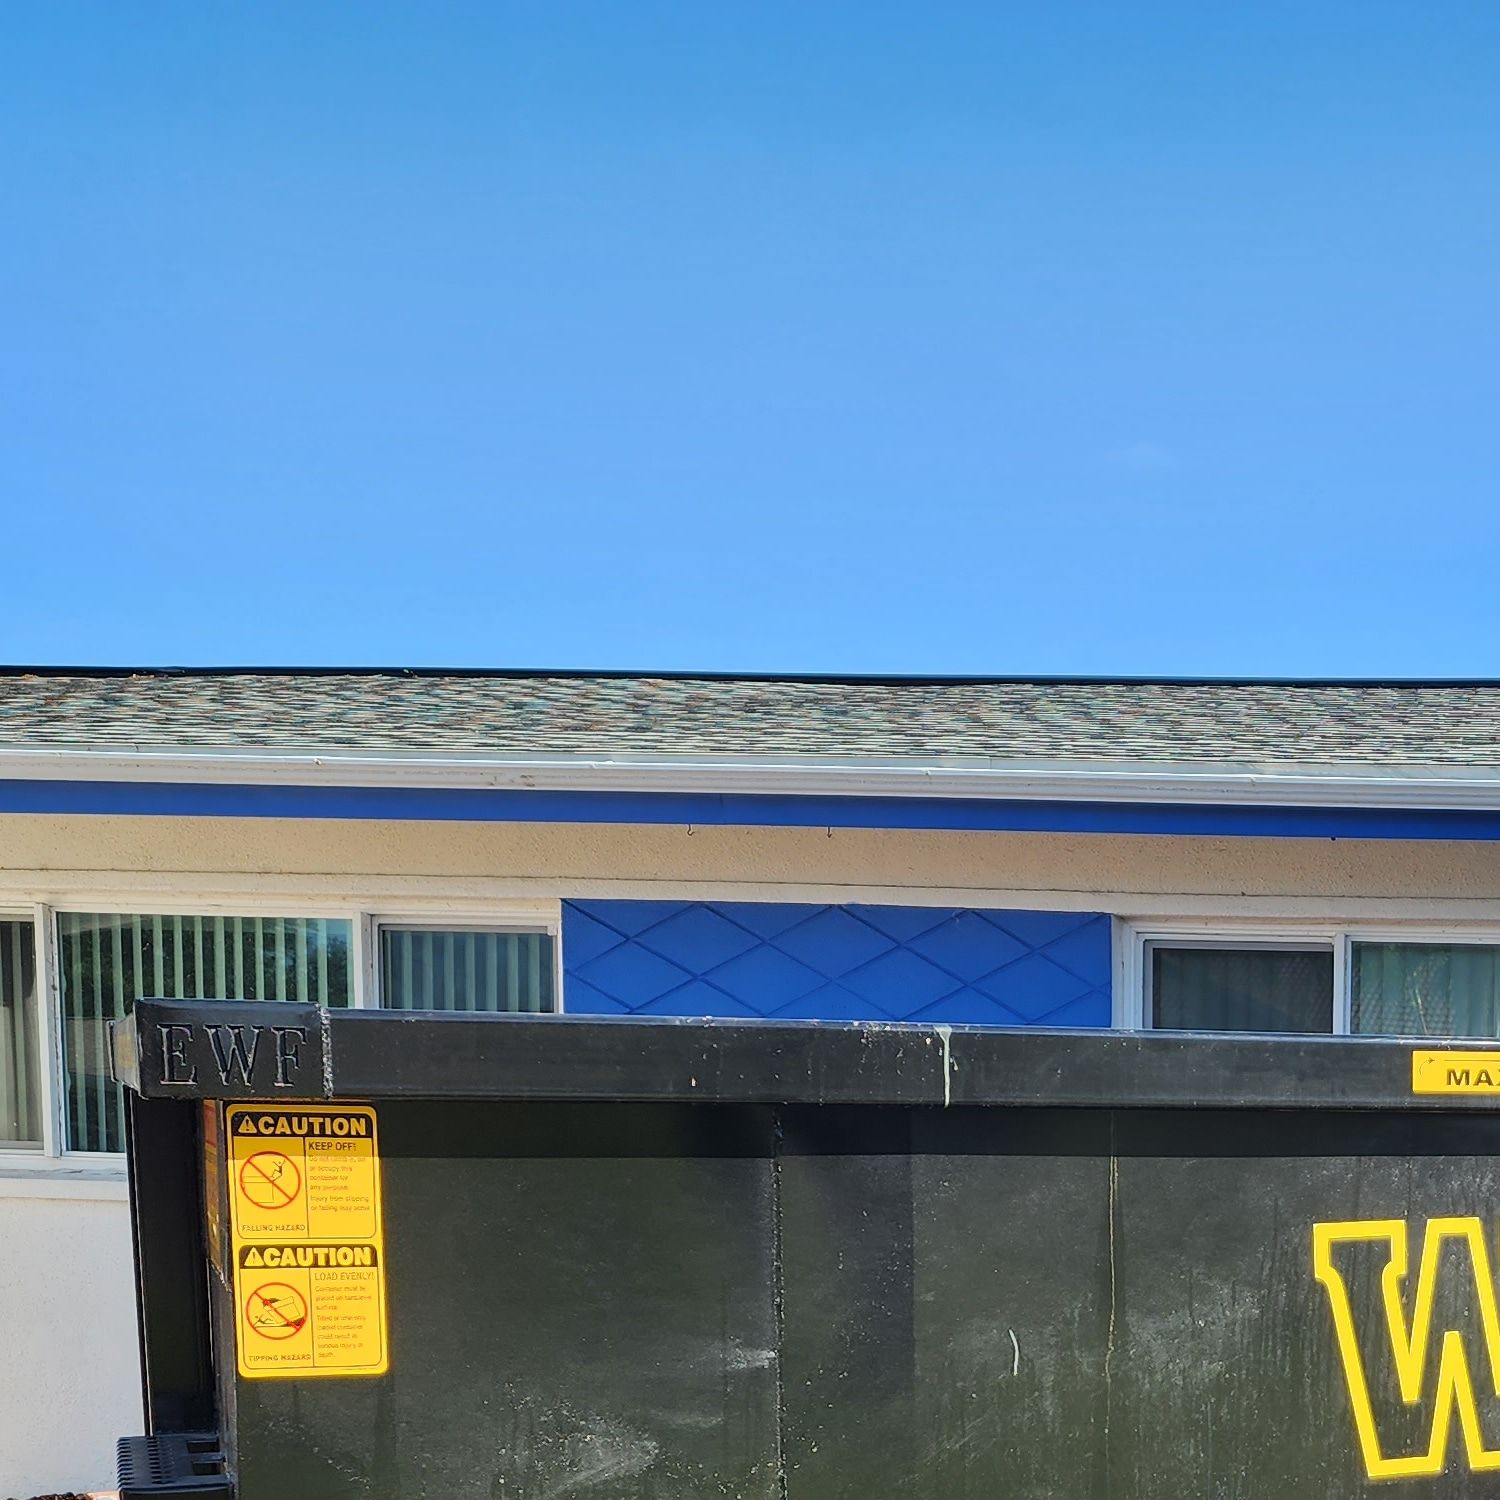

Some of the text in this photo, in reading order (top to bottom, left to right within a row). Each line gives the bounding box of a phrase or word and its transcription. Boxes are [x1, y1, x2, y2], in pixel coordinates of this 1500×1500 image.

[157, 1023, 308, 1087] EWF
[258, 1116, 367, 1136] CAUTION
[308, 1141, 333, 1150] KEEP
[242, 1224, 273, 1232] FALLING
[263, 1247, 372, 1267] CAUTION
[314, 1271, 338, 1281] LOAD
